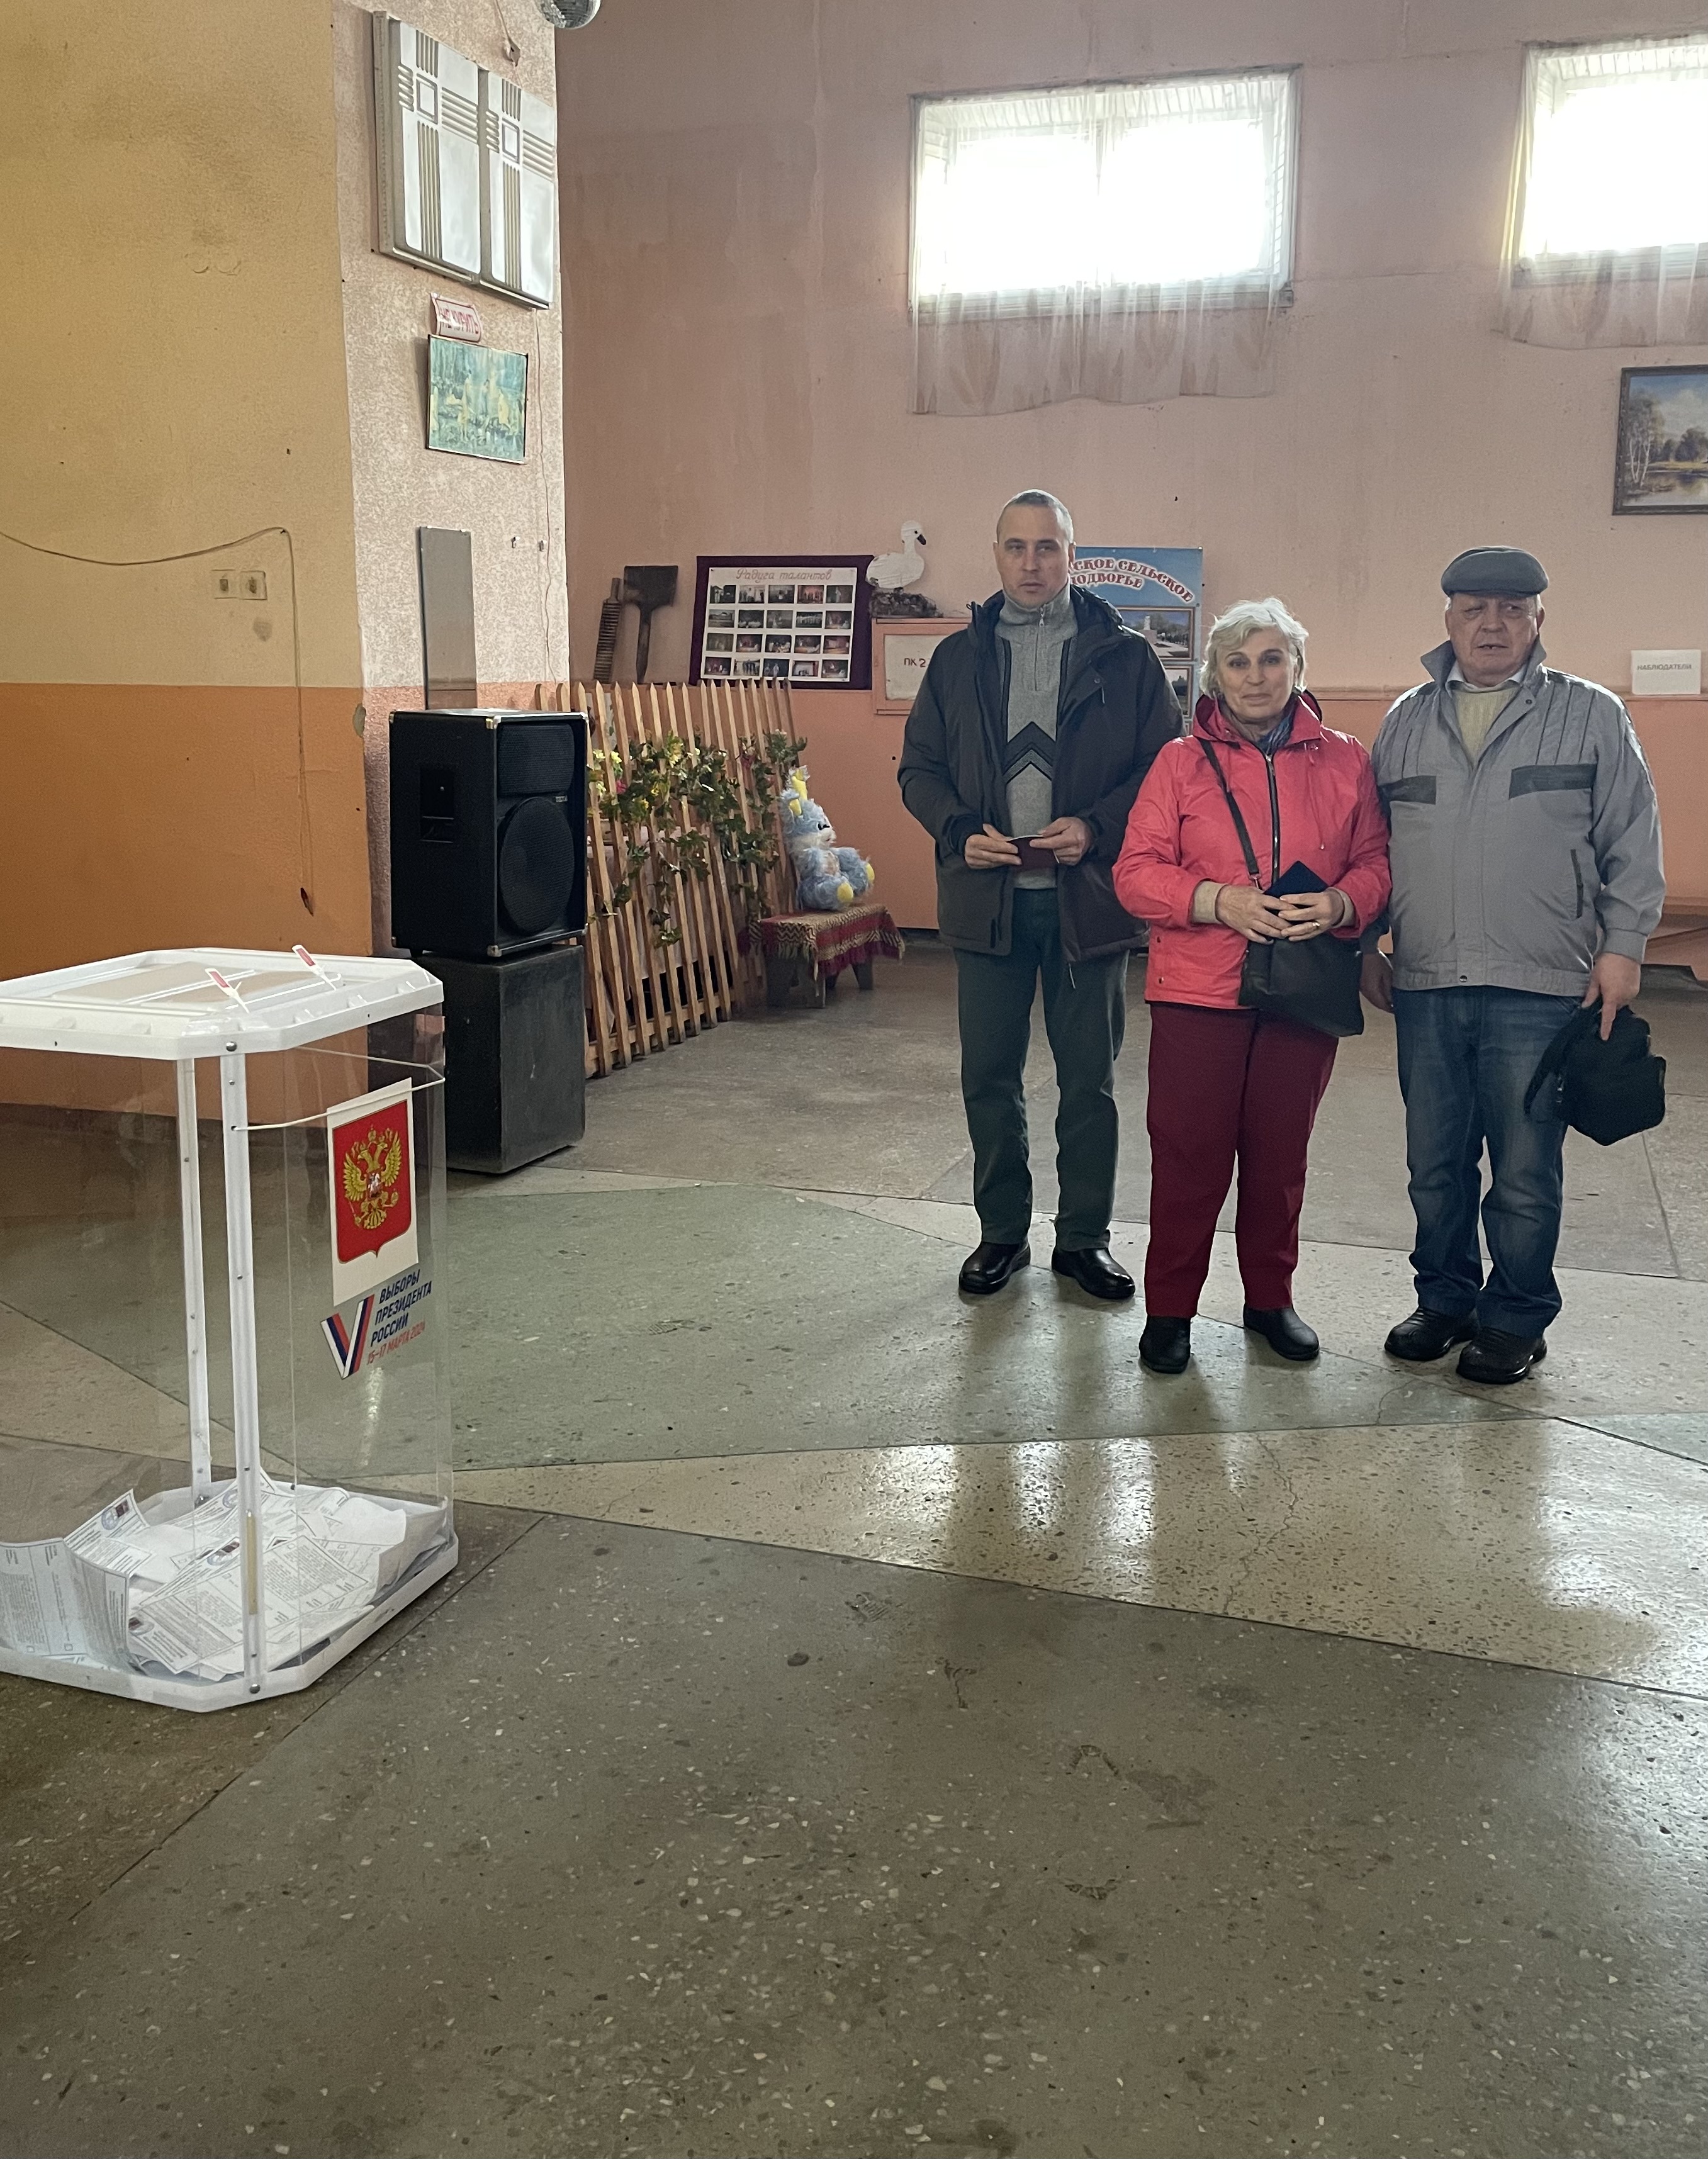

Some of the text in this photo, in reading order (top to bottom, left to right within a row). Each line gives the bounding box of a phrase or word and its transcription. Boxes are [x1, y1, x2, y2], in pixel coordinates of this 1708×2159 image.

[736, 568, 833, 583] Радуга талантов
[1069, 559, 1193, 602] СКОЕ СЕЛЬСКОЕ
[904, 658, 926, 668] ПК 2
[374, 1281, 432, 1326] ПРЕЗИДЕНТА
[379, 1269, 420, 1304] ВЫБОРЫ
[370, 1313, 409, 1348] РОССИИ
